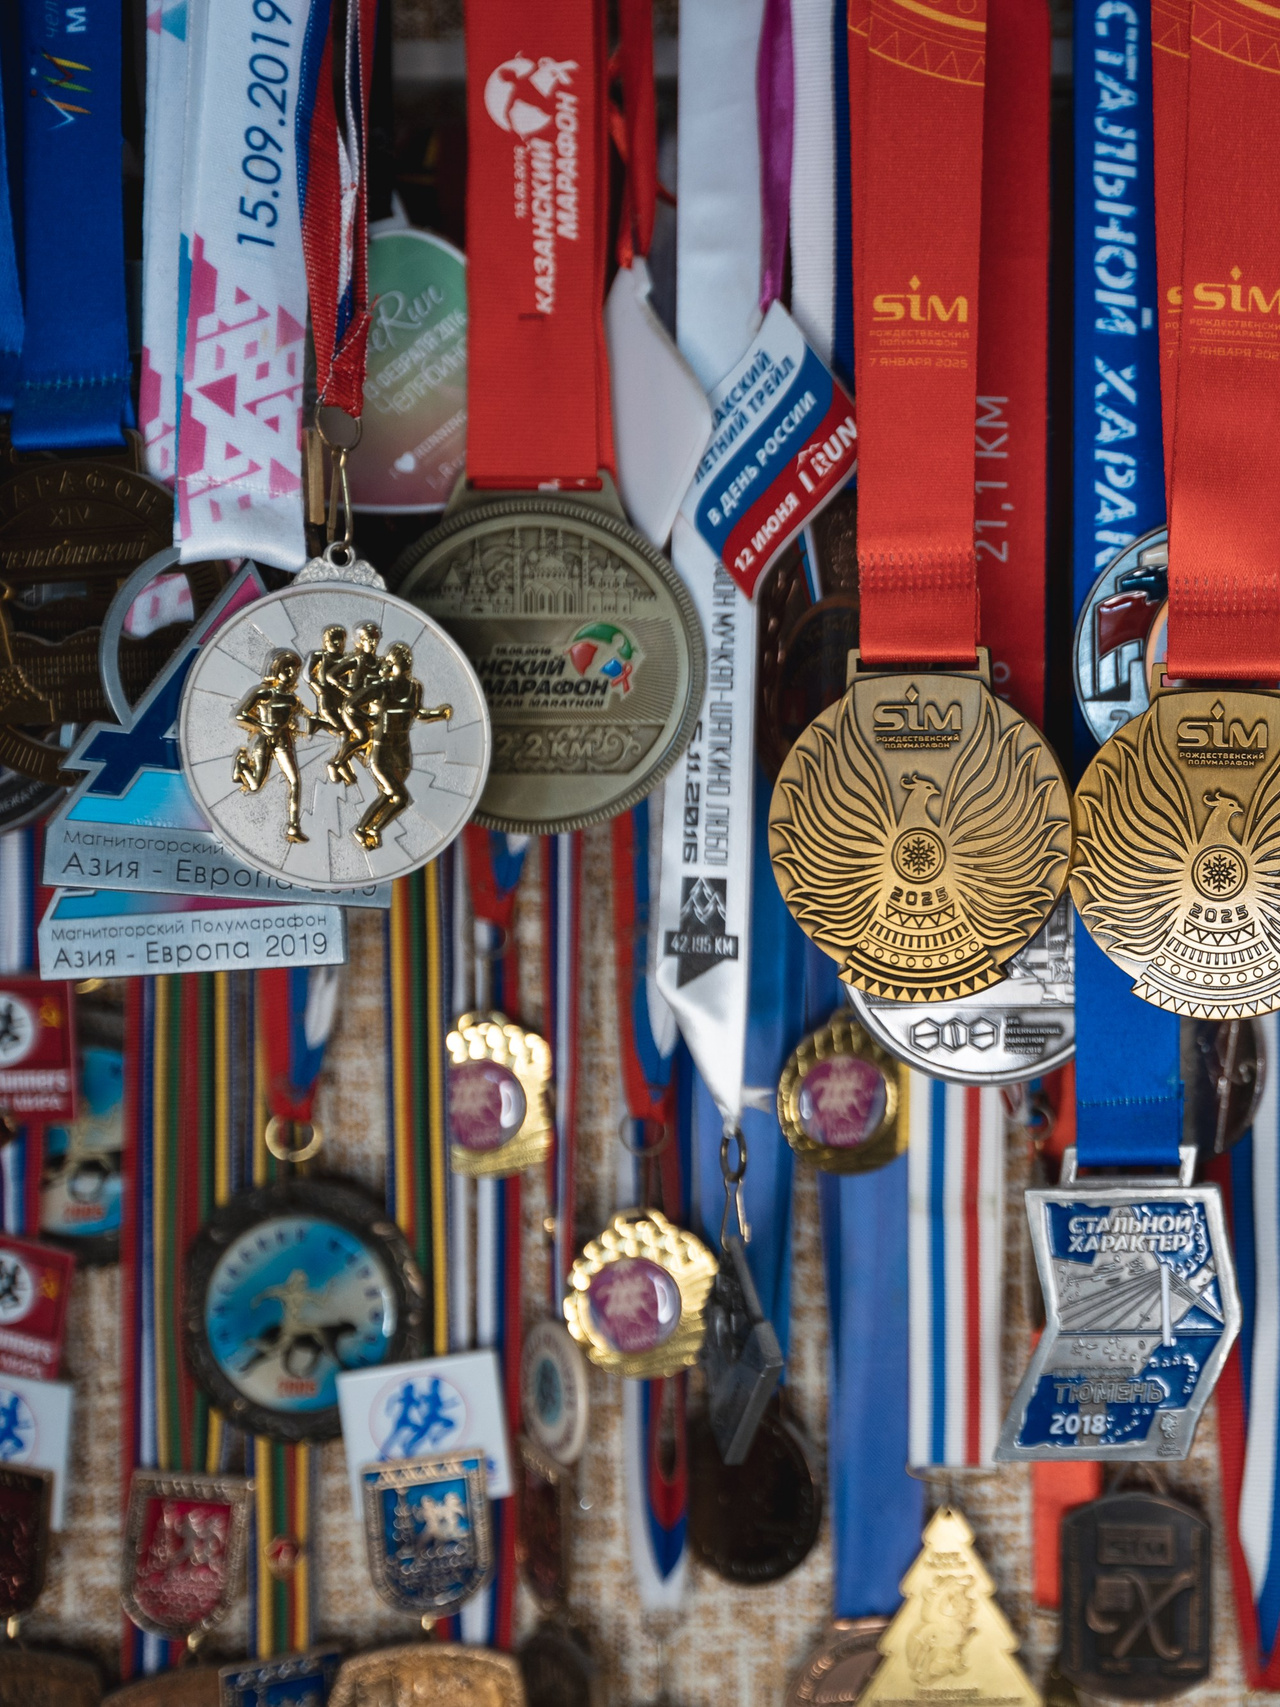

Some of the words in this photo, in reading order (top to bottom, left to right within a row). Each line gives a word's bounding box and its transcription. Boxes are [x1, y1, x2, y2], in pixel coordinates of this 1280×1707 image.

[237, 0, 293, 250] 15.09.2019
[555, 91, 579, 240] МАРАФОН
[1094, 0, 1152, 335] СТАЛЬНОЙ
[529, 137, 556, 314] КАЗАНСКИЙ
[869, 329, 970, 340] РОЖДЕСТВЕНСКИЙ
[879, 339, 959, 348] ПОЛУМАРАФОН
[1199, 327, 1278, 340] ПОЛУМАРАФОН
[1189, 346, 1196, 356] 7
[1199, 347, 1251, 358] ЯНВАРЯ
[869, 358, 877, 368] 7
[880, 358, 932, 368] ЯНВАРЯ
[935, 358, 968, 369] 2025
[747, 354, 796, 416] ТРЕЙЛ
[707, 508, 722, 528] В
[719, 463, 759, 518] ДЕНЬ
[755, 390, 818, 468] РОССИИ
[50, 506, 91, 527] XIV
[734, 551, 755, 574] 12
[751, 491, 801, 553] ИЮНЯ
[482, 678, 609, 695] МАРАФОН
[876, 733, 960, 743] РОЖДЕСТВЕНСКИЙ
[884, 742, 950, 750] ПОЛУМАРАФОН
[1179, 751, 1265, 760] РОЖДЕСТВЕНСКИЙ
[1188, 759, 1255, 767] ПОЛУМАРАФОН
[63, 829, 225, 857] Магнитогорский
[62, 852, 140, 879] Азия
[889, 886, 949, 907] 2025
[1189, 903, 1250, 923] 2025
[51, 919, 185, 942] Магнитогорский
[191, 913, 328, 935] Полумарафон
[53, 946, 116, 970] Азия
[146, 940, 250, 965] Европа
[265, 933, 328, 957] 2019
[714, 932, 734, 957] KM
[1068, 1213, 1193, 1235] СТАЛЬНОЙ
[1067, 1234, 1191, 1254] ХАРАКТЕР
[1053, 1378, 1165, 1405] ТЮМЕНЬ
[1049, 1413, 1108, 1436] 2018
